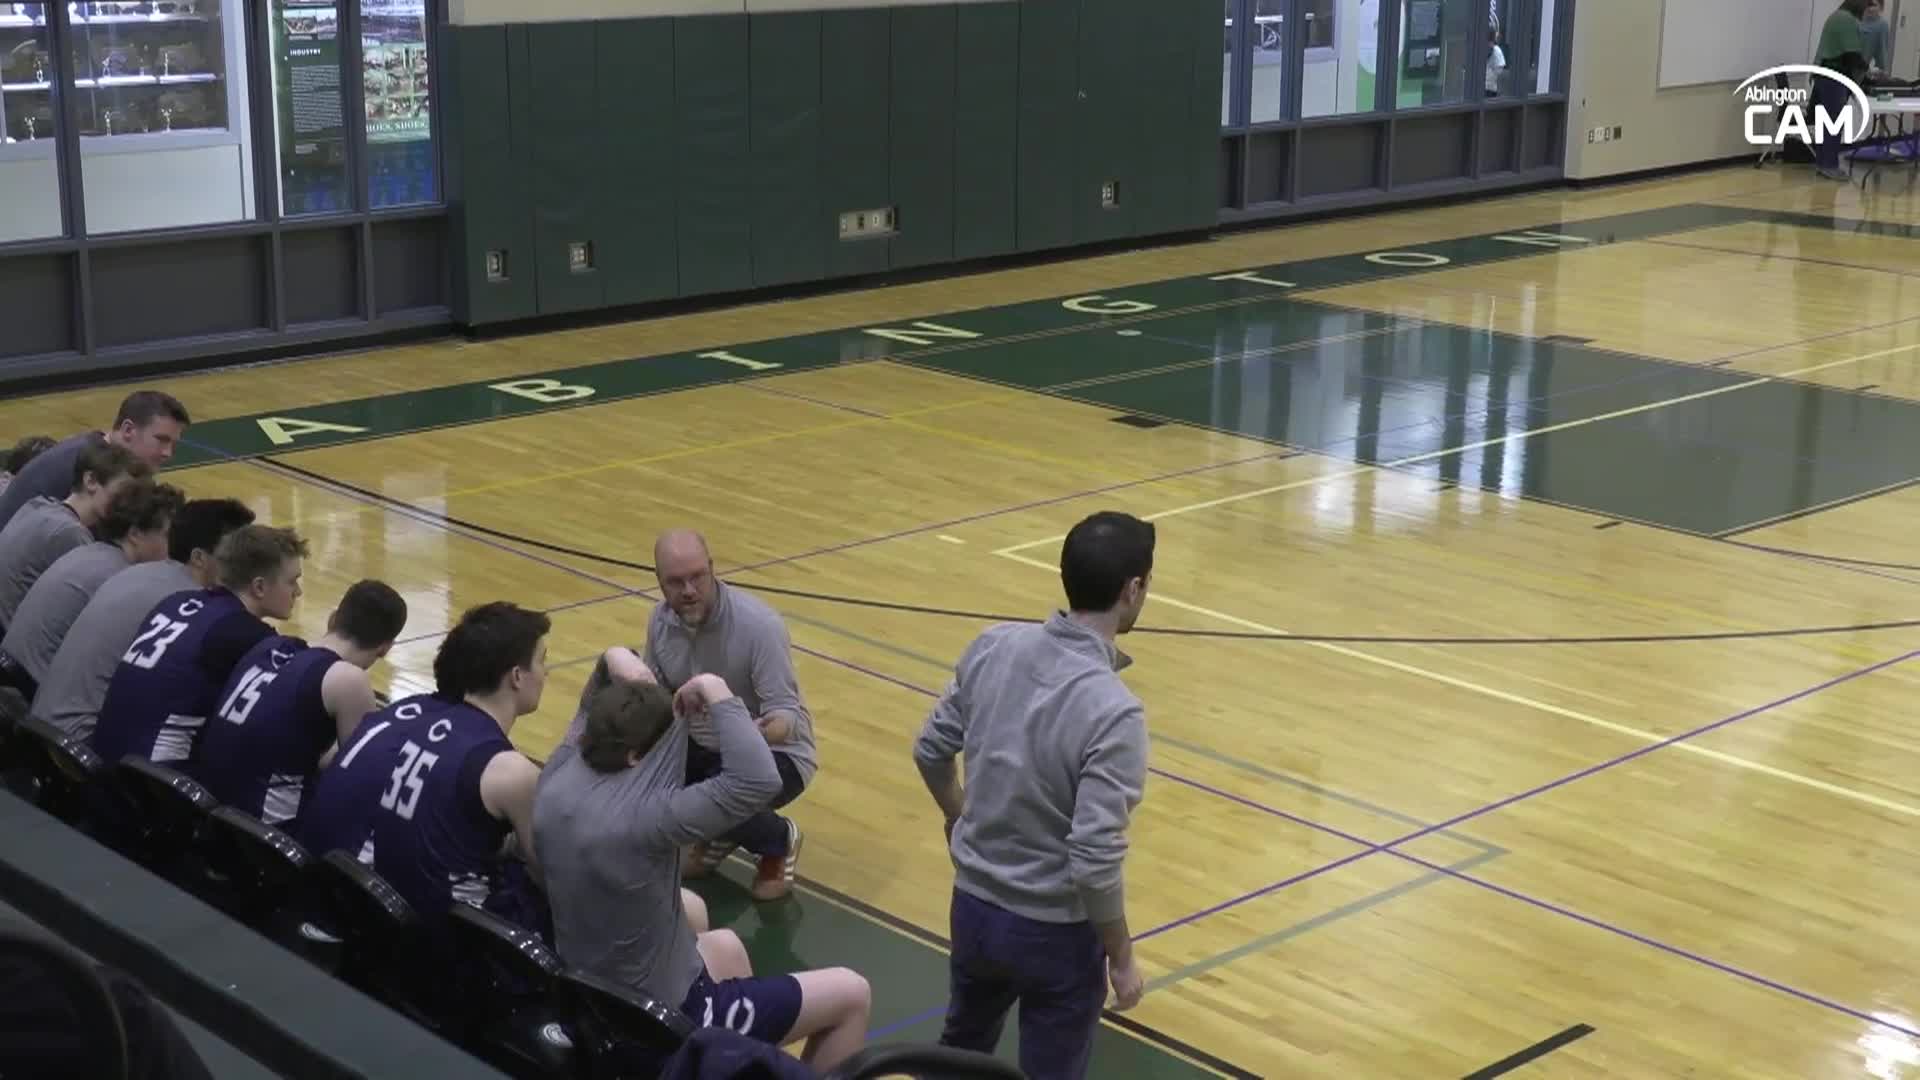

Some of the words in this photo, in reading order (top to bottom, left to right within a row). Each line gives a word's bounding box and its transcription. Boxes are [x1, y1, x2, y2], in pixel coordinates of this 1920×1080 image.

[289, 48, 321, 56] INDUSTRY
[178, 599, 204, 616] C
[122, 613, 189, 669] 23
[218, 665, 278, 725] 15
[395, 703, 422, 720] C
[428, 718, 452, 742] C
[380, 740, 439, 820] 35
